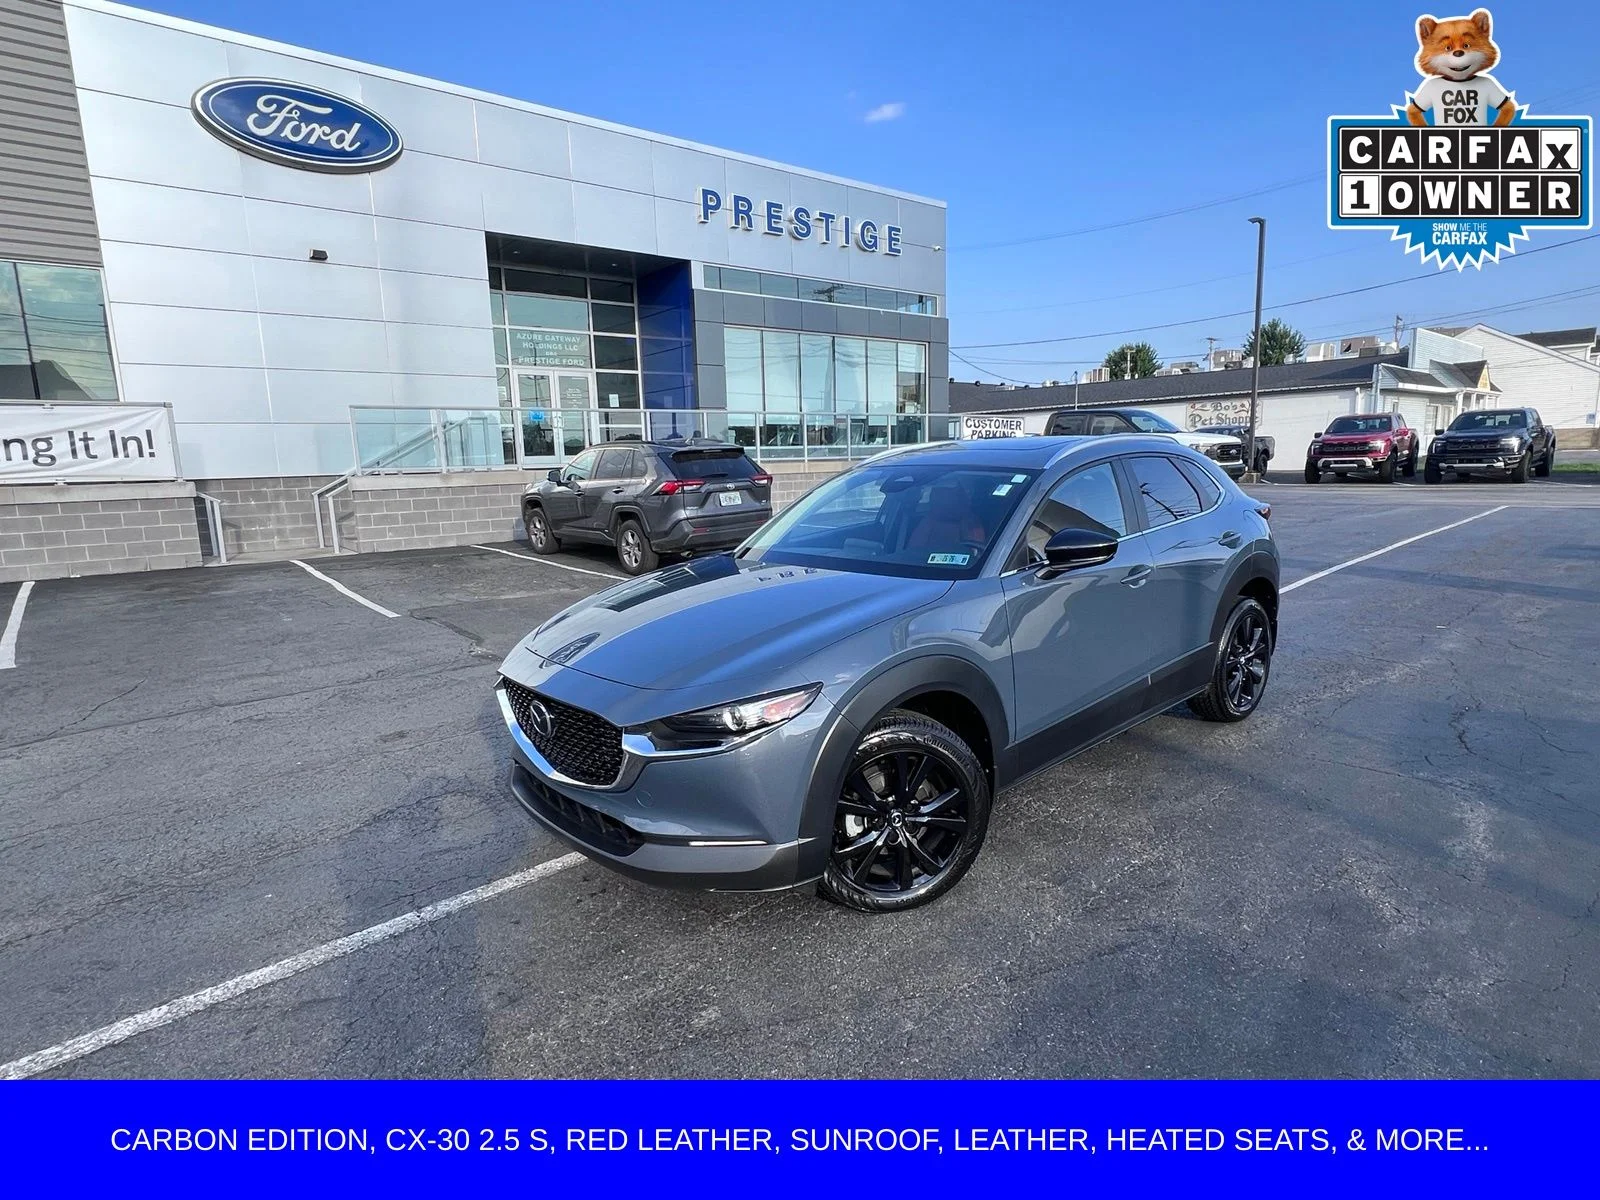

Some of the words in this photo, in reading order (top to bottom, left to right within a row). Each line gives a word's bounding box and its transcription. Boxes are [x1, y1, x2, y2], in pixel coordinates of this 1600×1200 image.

[247, 94, 362, 152] Ford
[699, 186, 903, 256] PRESTIGE
[516, 332, 542, 341] AZURE
[545, 334, 581, 344] GATEWAY
[522, 341, 563, 351] HOLDINGS
[564, 343, 579, 351] LLC
[519, 355, 561, 365] PRESTIGE
[562, 358, 585, 366] FORD
[1210, 402, 1238, 416] Bo's
[965, 417, 1022, 431] CUSTOMER
[1189, 413, 1214, 428] Pet
[67, 430, 98, 460] It
[109, 429, 156, 458] In!
